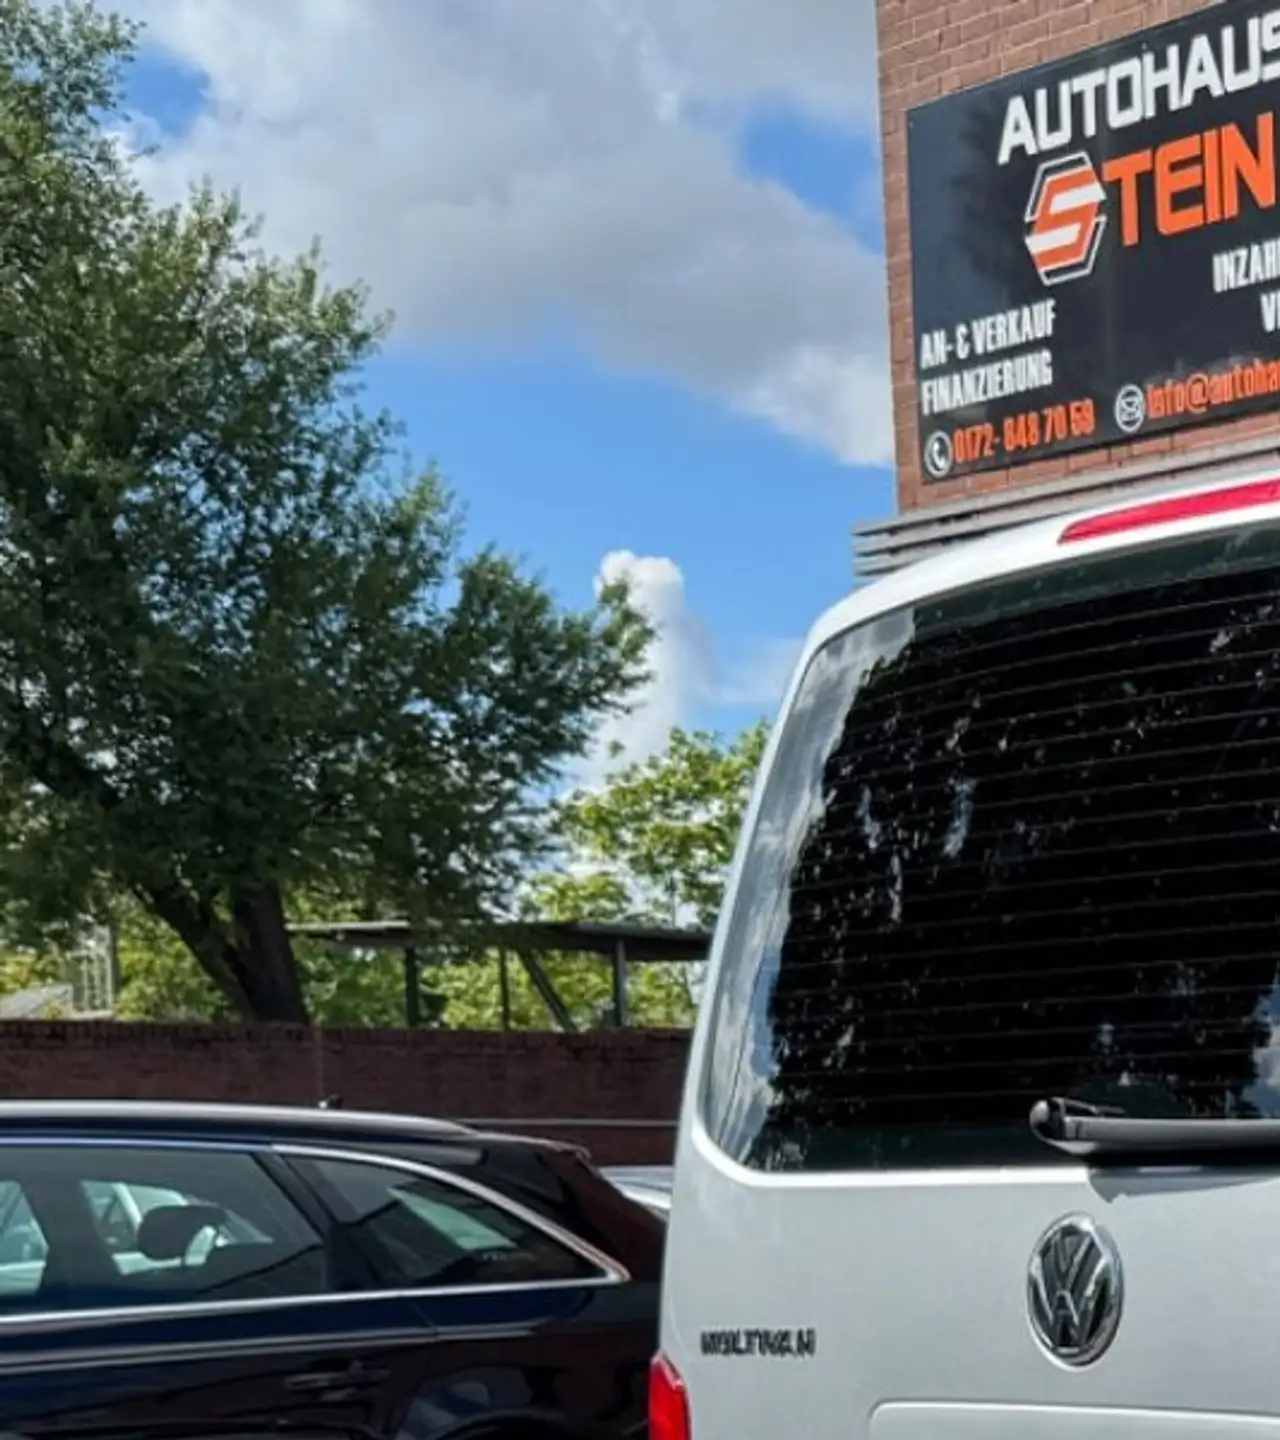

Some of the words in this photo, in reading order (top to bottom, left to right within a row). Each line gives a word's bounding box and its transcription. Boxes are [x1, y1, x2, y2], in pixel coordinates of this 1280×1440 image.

[1026, 112, 1277, 272] STEIN
[920, 330, 952, 369] AN-
[955, 324, 970, 360] &
[972, 298, 1057, 355] VERKAUF
[921, 348, 1053, 417] FINANZIERUNG
